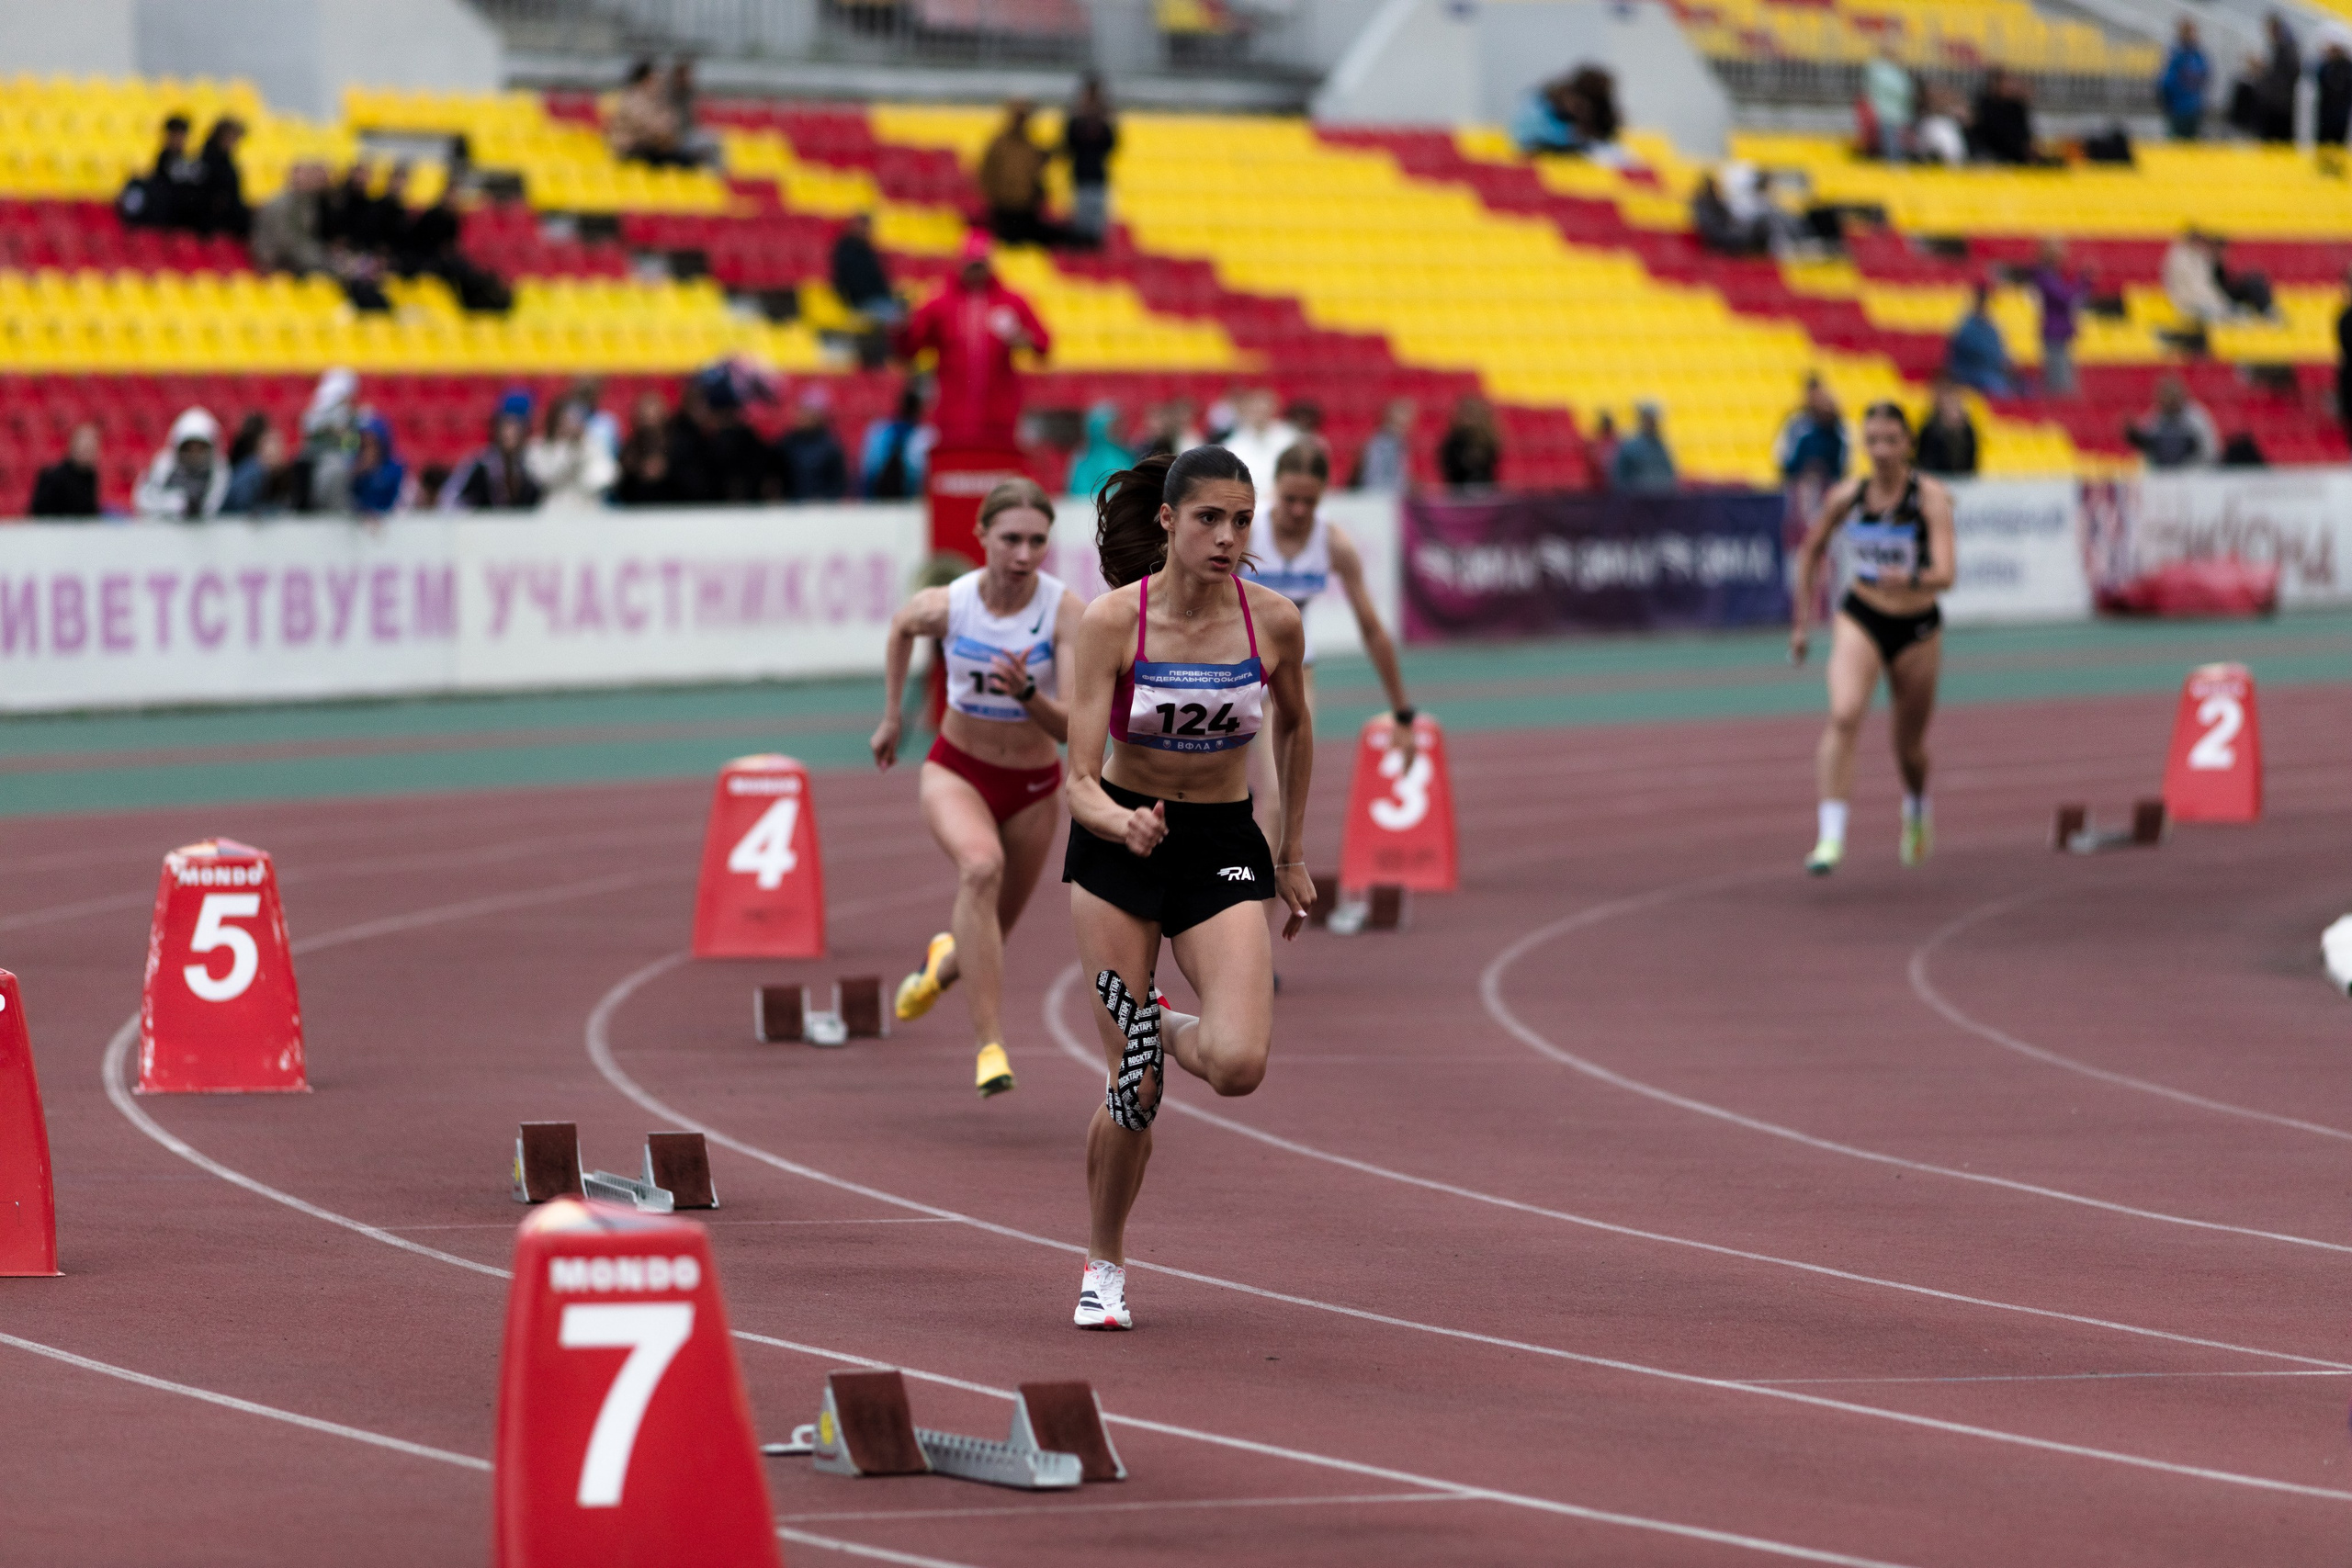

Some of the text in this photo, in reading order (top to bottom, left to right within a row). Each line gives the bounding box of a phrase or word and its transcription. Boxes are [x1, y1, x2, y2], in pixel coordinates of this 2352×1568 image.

[1156, 703, 1240, 735] 124
[1177, 741, 1211, 750] ВФЛА
[2188, 695, 2244, 771] 2
[1369, 751, 1432, 830] 3
[728, 797, 799, 889] 4
[176, 865, 264, 886] MONDO
[183, 893, 261, 1002] 5
[1106, 976, 1122, 1011] ROCKTAPE
[548, 1256, 700, 1292] MONDO
[559, 1302, 696, 1507] 7
